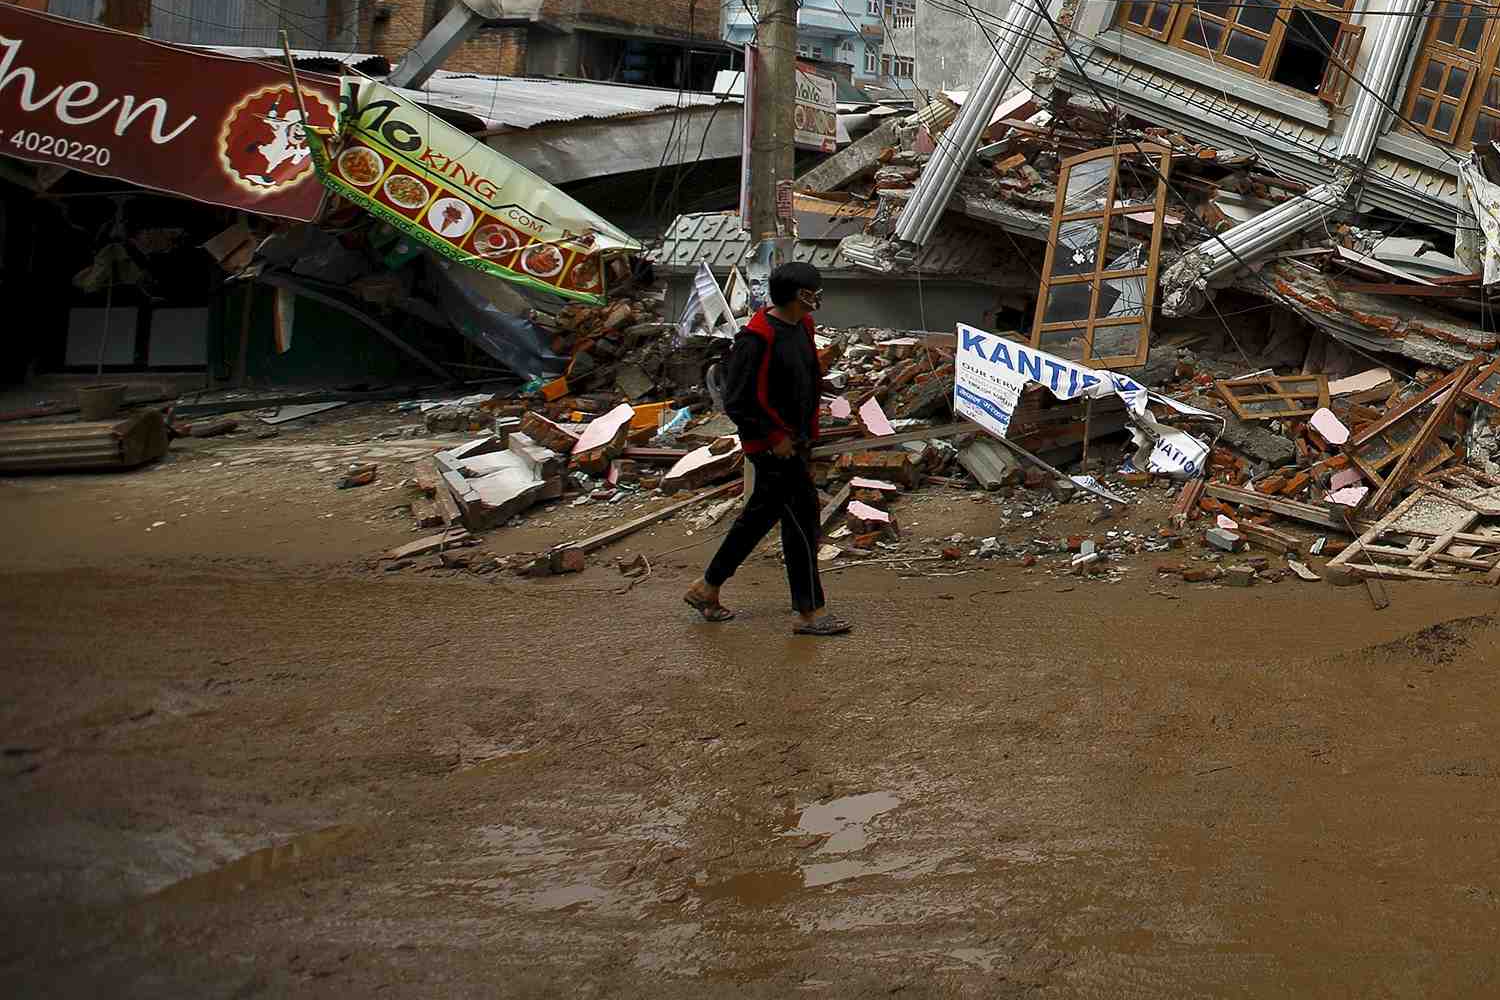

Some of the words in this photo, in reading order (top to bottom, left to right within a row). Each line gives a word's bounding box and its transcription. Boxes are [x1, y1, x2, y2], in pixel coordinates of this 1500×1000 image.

[10, 130, 111, 167] 4020220
[418, 146, 502, 201] KING
[961, 362, 987, 378] OUR
